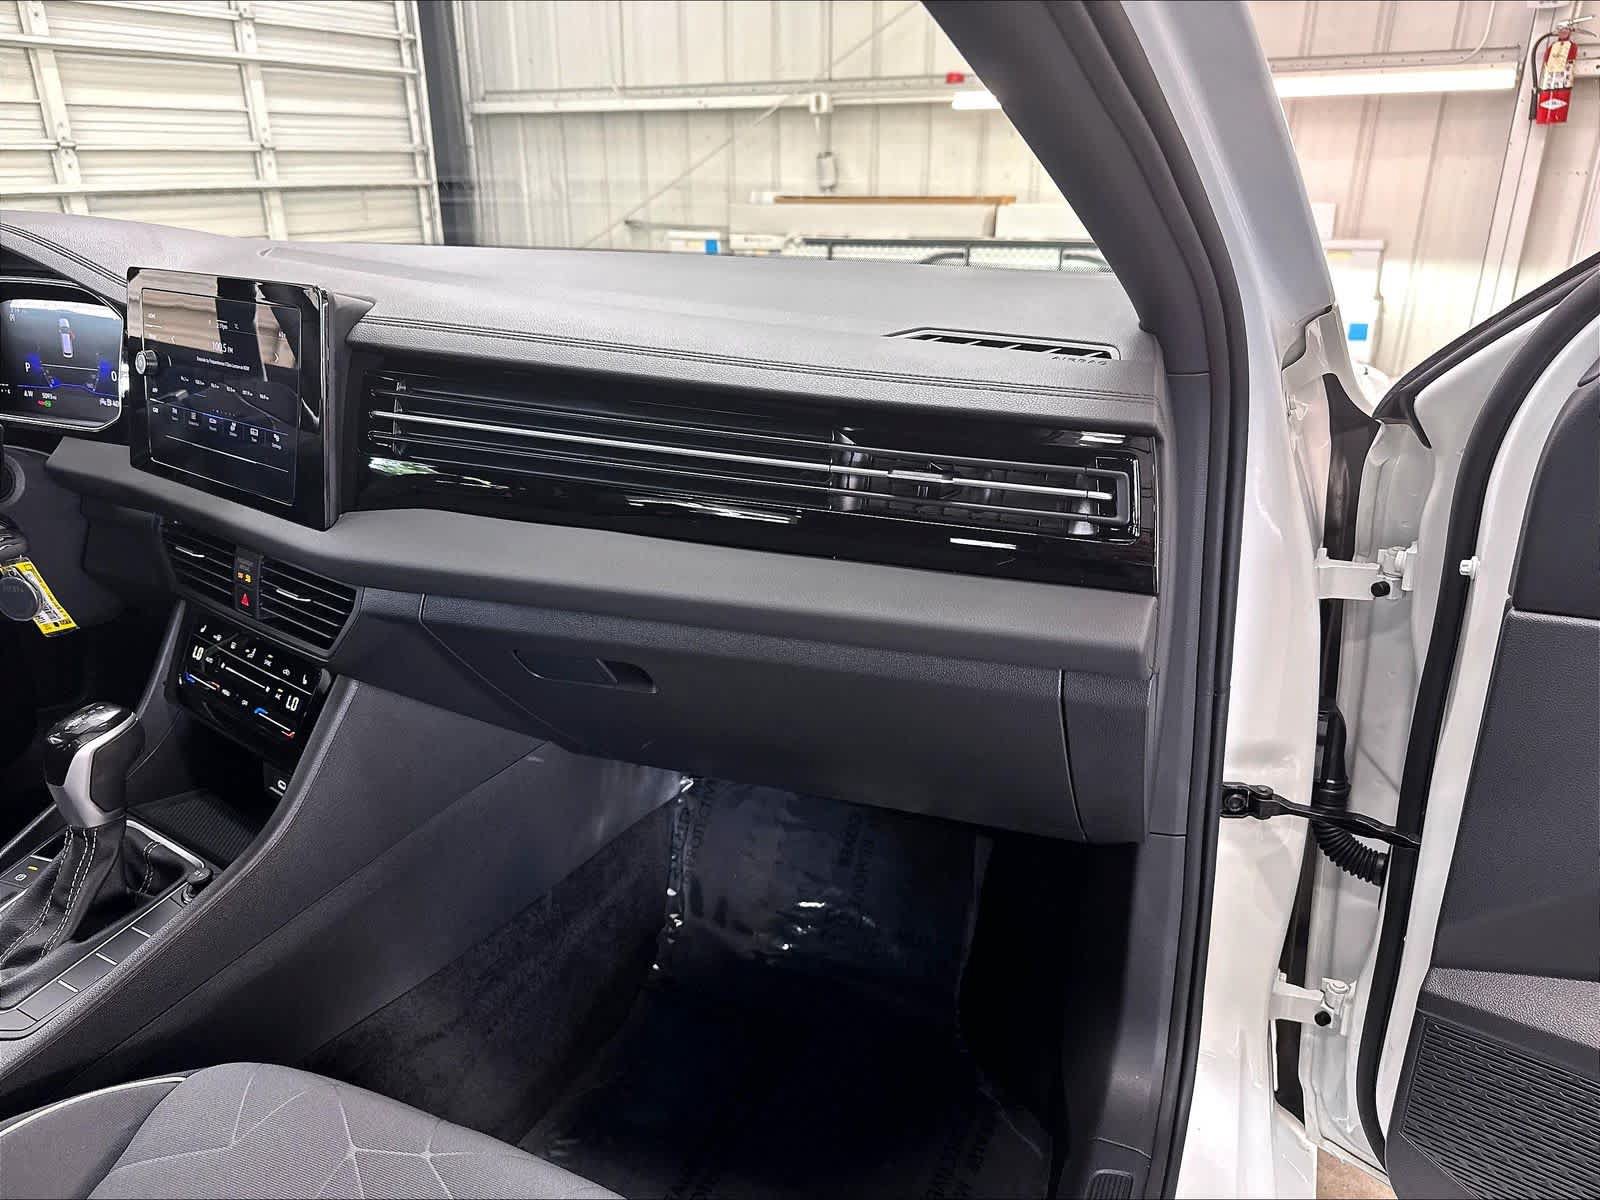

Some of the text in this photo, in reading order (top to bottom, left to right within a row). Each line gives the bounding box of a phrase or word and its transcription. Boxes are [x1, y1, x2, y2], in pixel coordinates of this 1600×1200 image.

[25, 362, 31, 373] P
[1051, 356, 1108, 366] AIRBAG
[192, 645, 204, 661] LO
[286, 694, 299, 711] LO
